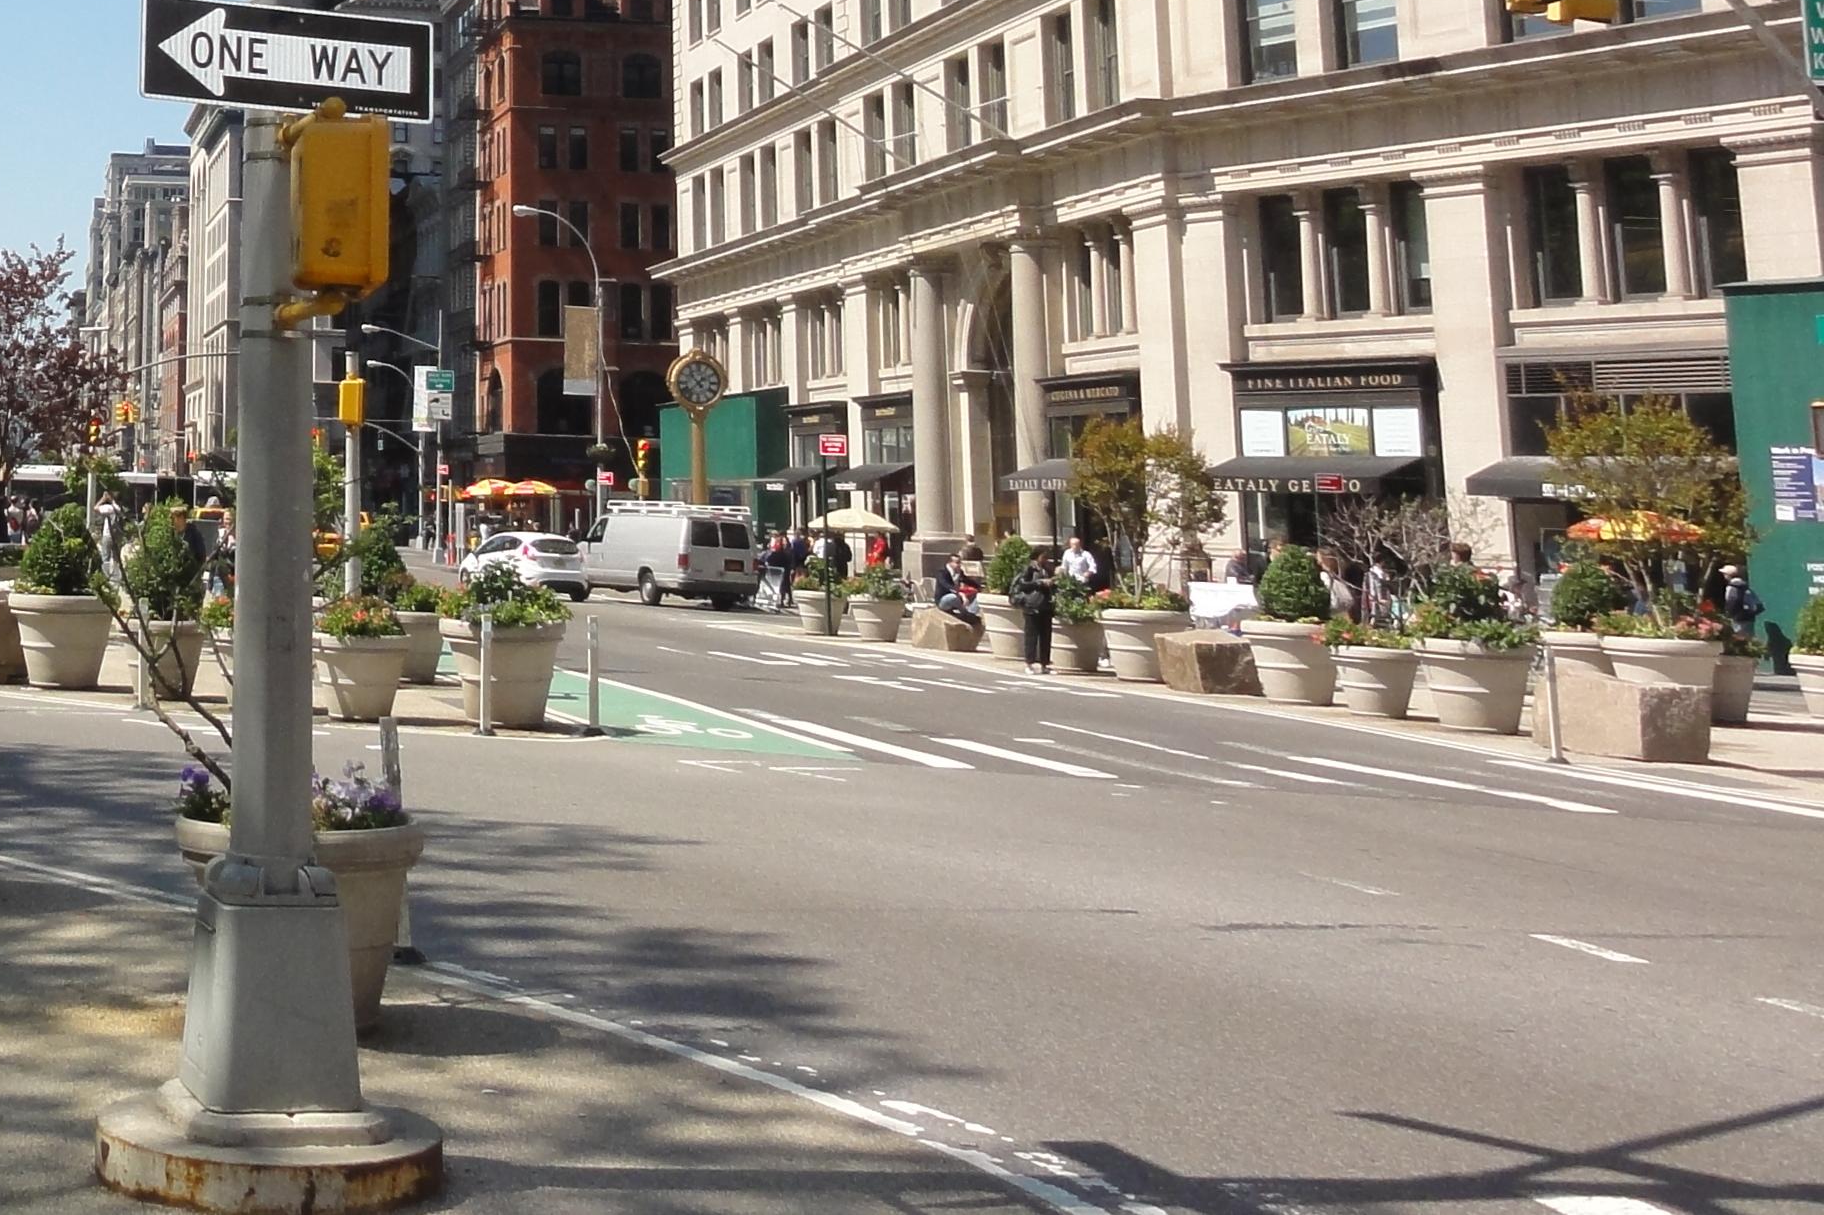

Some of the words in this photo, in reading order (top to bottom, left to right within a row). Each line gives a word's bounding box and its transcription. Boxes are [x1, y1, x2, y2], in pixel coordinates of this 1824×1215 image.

[190, 31, 268, 76] ONE
[310, 44, 393, 86] WAY
[1247, 377, 1284, 389] FINE
[1289, 376, 1353, 388] ITALIAN
[1360, 373, 1402, 386] FOOD
[1306, 433, 1350, 445] EATALY
[1008, 478, 1038, 490] EATALY
[1212, 477, 1279, 492] EATALY
[1287, 478, 1361, 492] GEO
